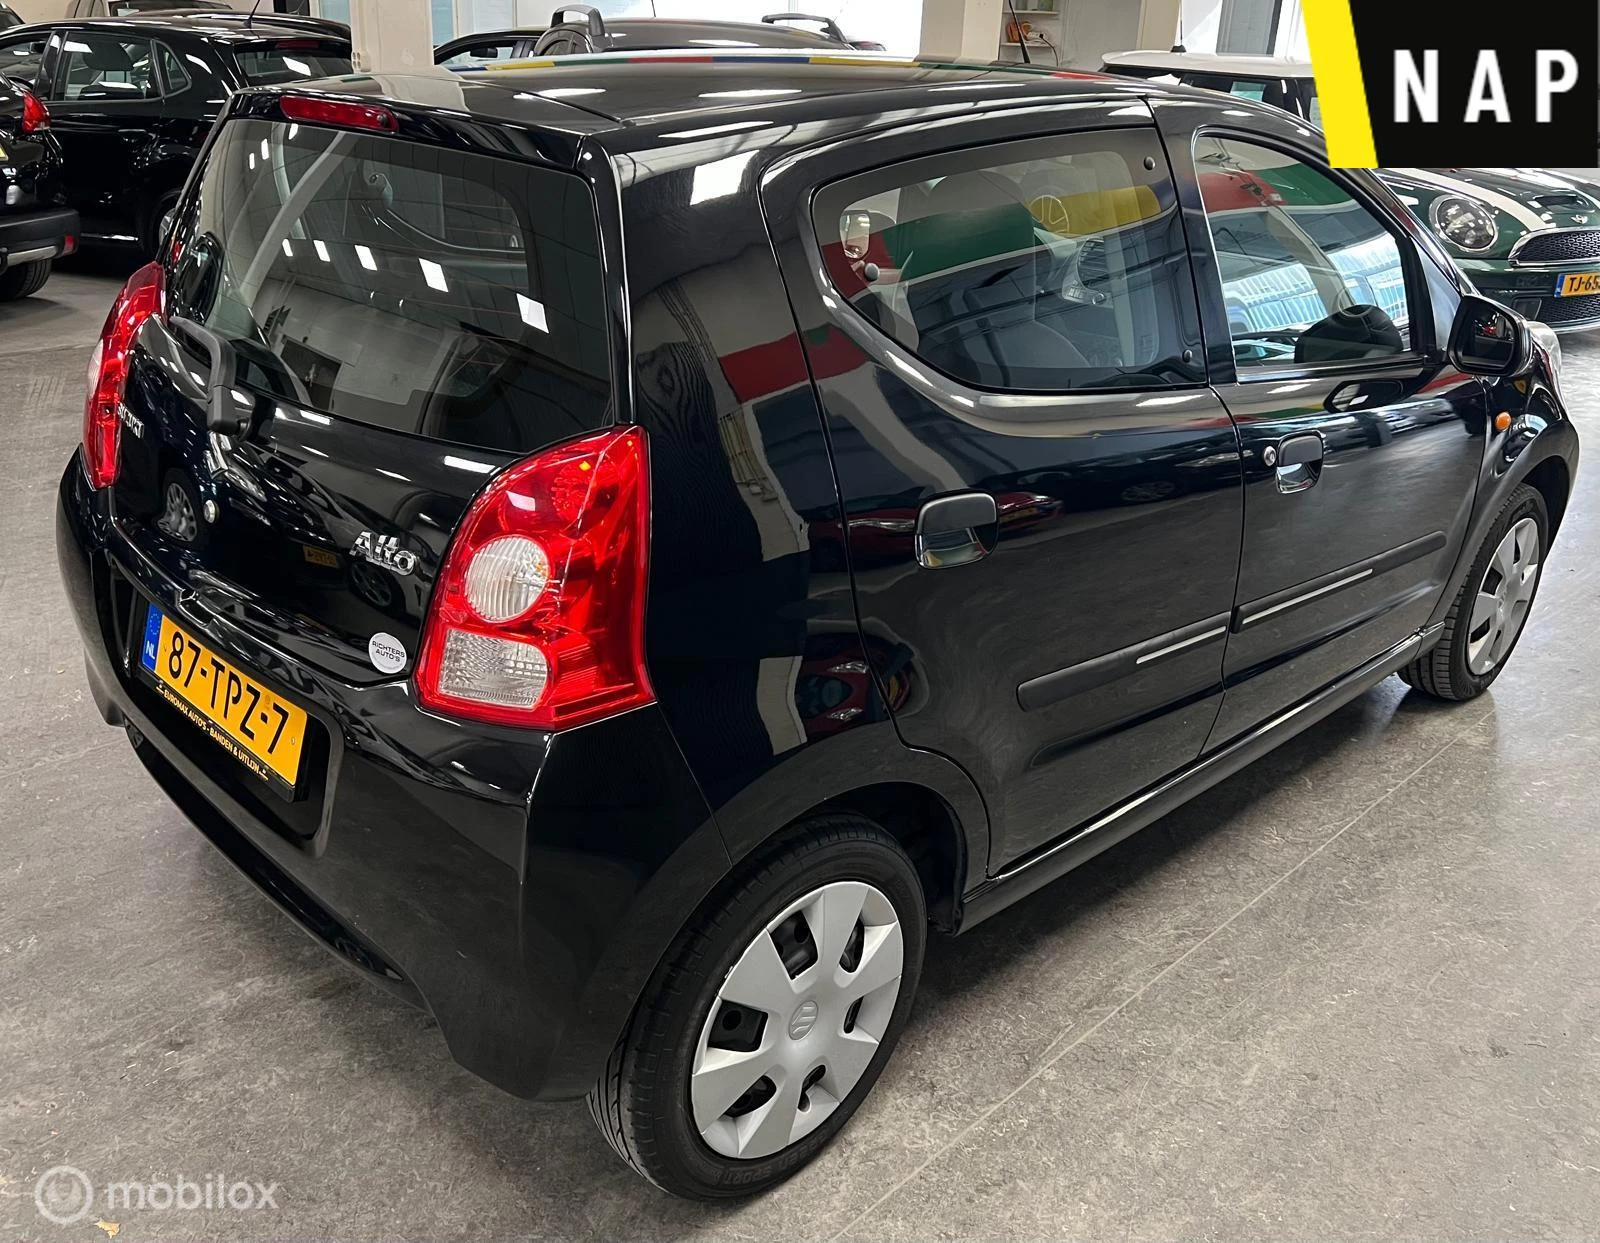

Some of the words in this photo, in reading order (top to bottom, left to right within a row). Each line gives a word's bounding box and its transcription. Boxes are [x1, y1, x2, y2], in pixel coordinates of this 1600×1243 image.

[1568, 275, 1600, 292] TJ-65
[349, 531, 416, 576] Alto
[145, 640, 156, 660] NL
[372, 640, 406, 658] RICHTERS
[375, 648, 401, 662] AUTO'S
[168, 631, 290, 755] 87-TPZ-7
[163, 689, 189, 716] EUROMAX
[188, 710, 207, 731] AUTO'S
[209, 727, 233, 753] BANDEN
